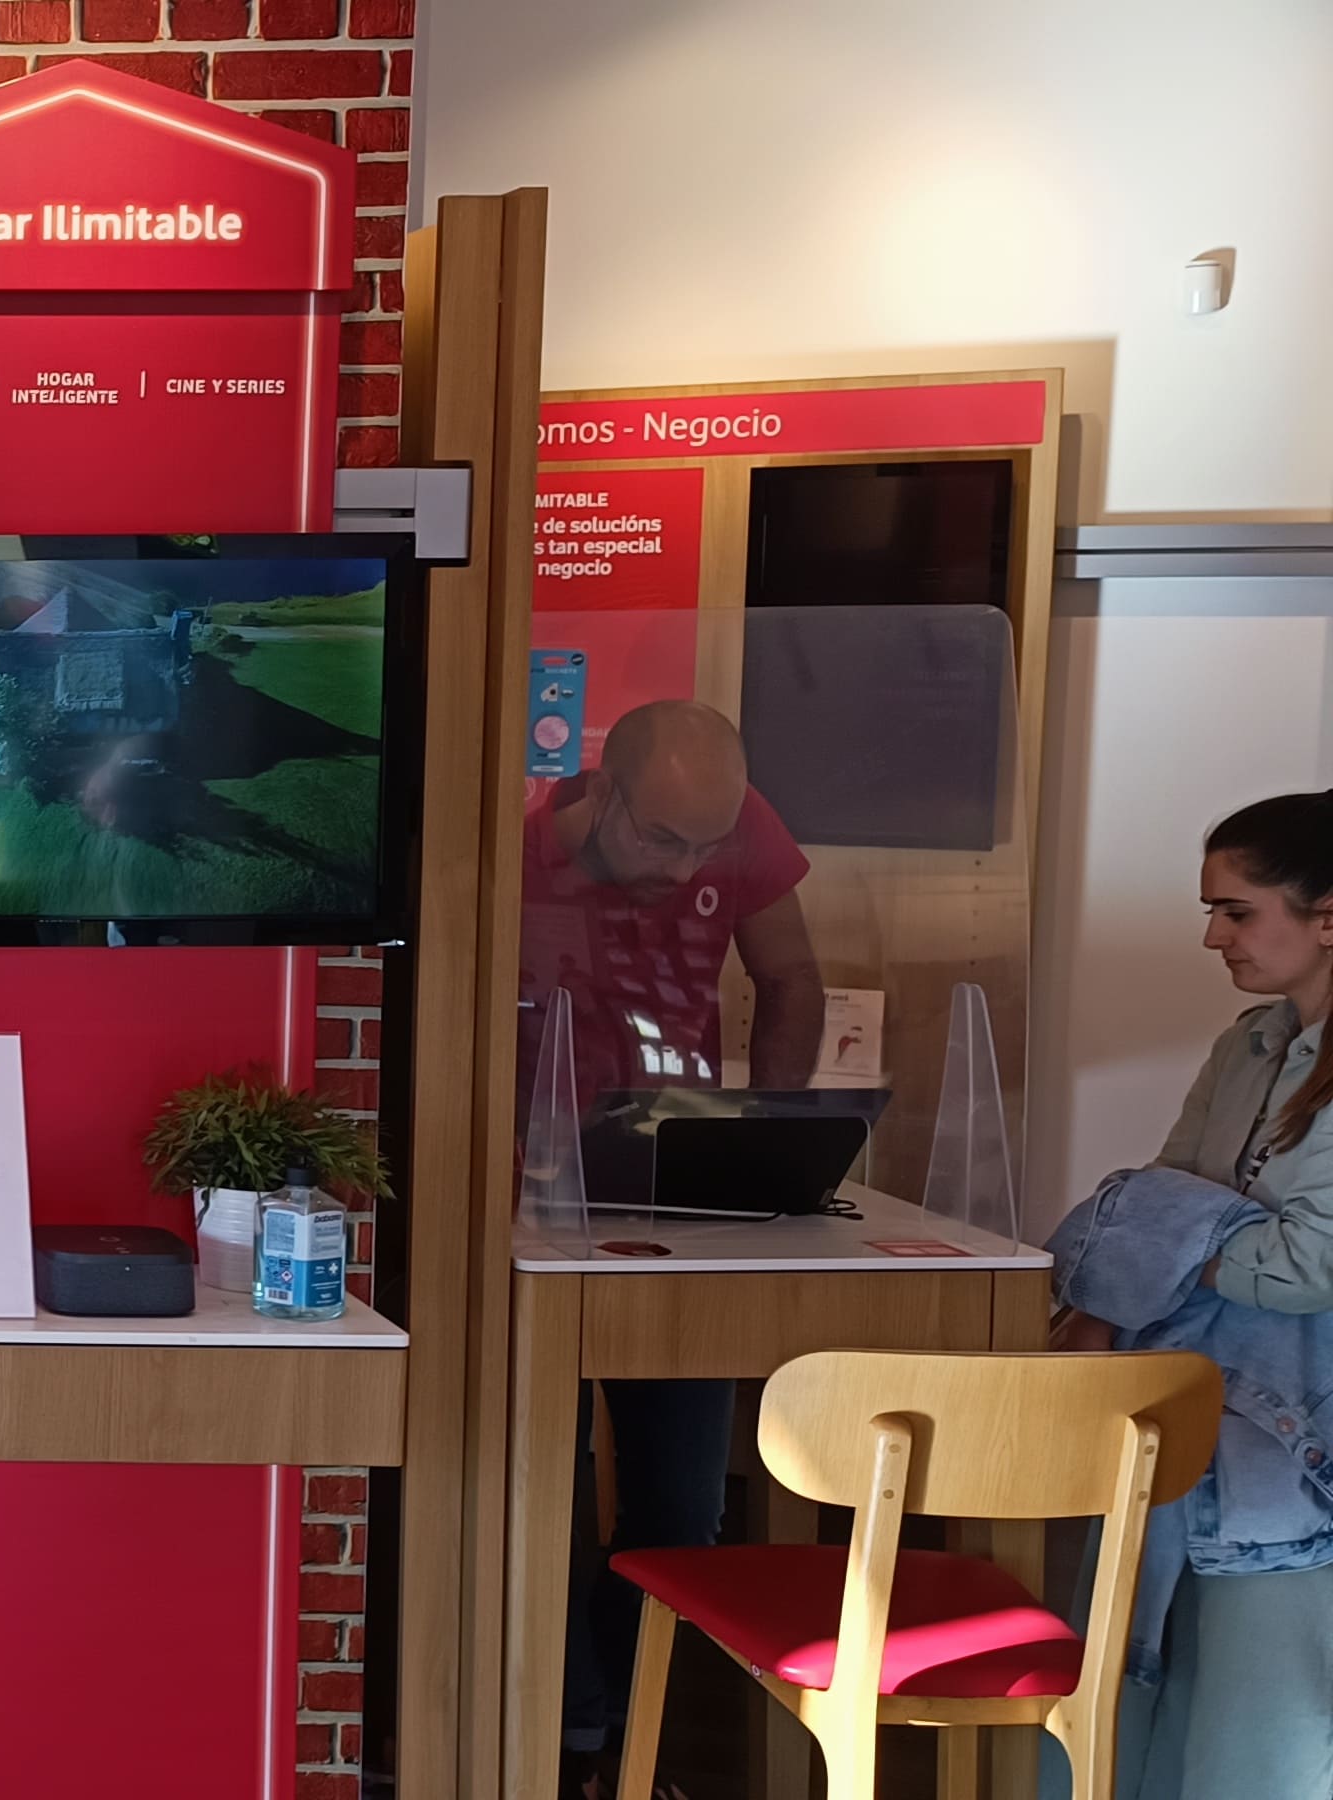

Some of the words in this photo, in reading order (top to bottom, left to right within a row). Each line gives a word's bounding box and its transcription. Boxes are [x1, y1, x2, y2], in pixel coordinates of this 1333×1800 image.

[42, 204, 243, 241] Ilimitable
[36, 372, 95, 387] HOGAR
[165, 378, 206, 394] CINE
[212, 380, 223, 394] Y
[226, 379, 285, 395] SERIES
[11, 389, 119, 405] INTELIGENTE
[643, 408, 782, 447] Negocio
[542, 517, 566, 534] de
[569, 514, 662, 533] solucións
[548, 539, 579, 556] tan
[583, 536, 662, 558] especial
[537, 558, 612, 580] negocio
